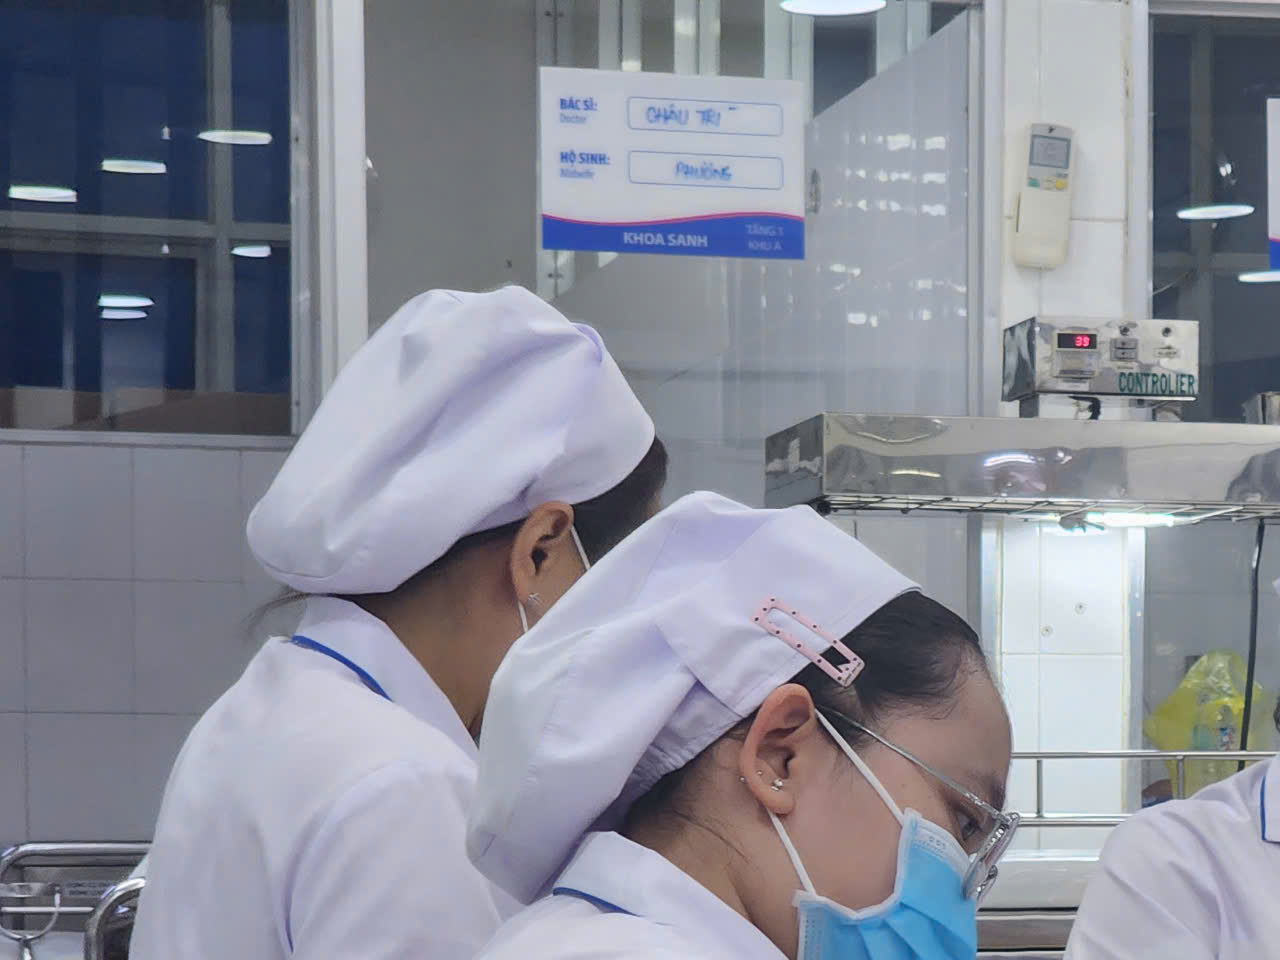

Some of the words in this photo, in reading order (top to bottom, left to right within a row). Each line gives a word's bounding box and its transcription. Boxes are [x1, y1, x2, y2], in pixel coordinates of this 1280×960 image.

[623, 231, 666, 246] KHOA
[668, 232, 708, 248] SANH
[772, 240, 782, 252] A
